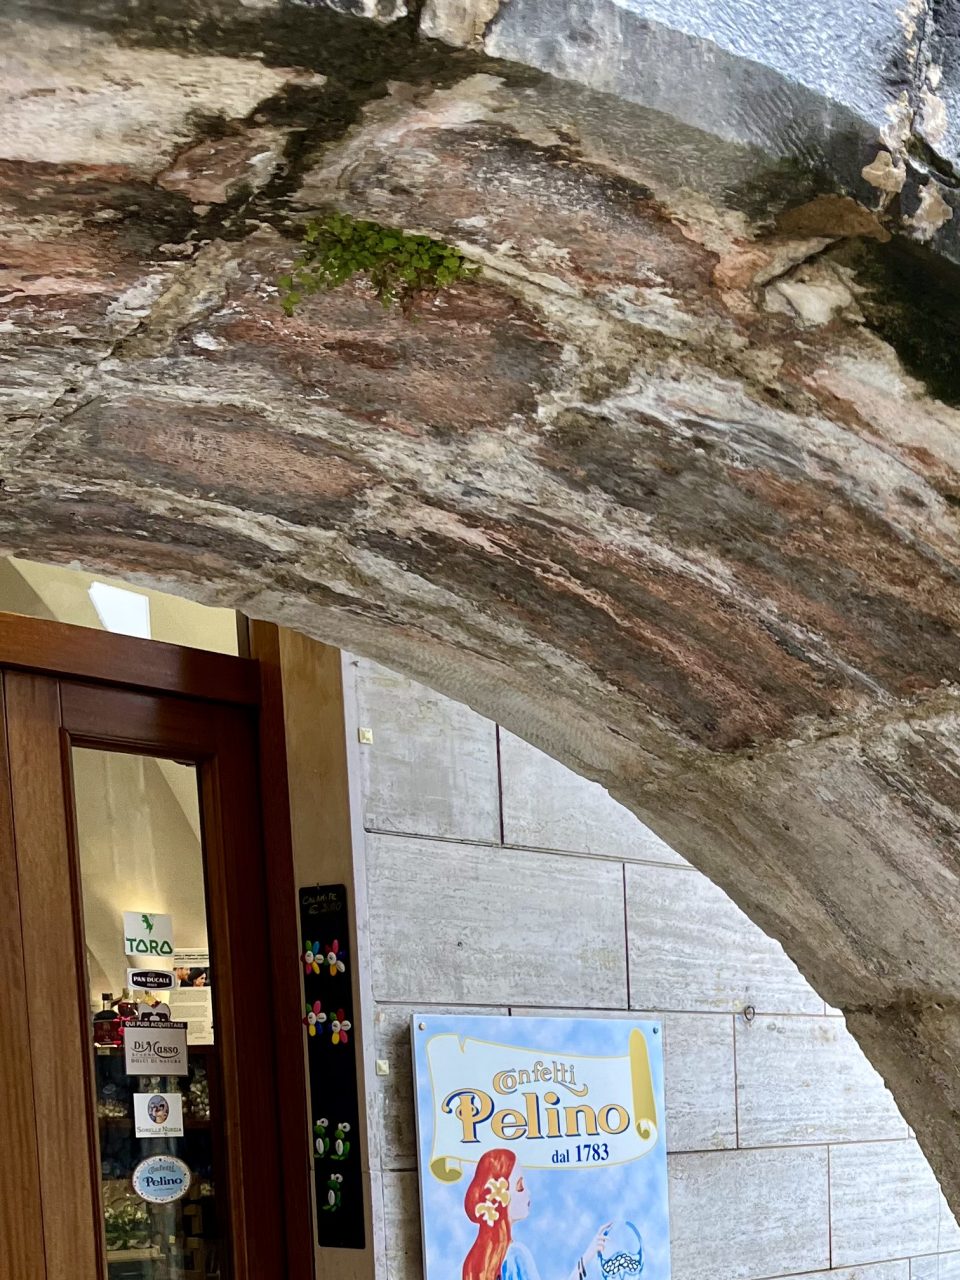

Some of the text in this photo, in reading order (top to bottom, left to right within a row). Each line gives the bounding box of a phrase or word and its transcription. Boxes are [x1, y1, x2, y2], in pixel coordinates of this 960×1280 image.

[126, 936, 173, 956] TORO
[492, 1060, 589, 1097] Confetti
[442, 1088, 631, 1144] Pelino
[552, 1143, 610, 1164] dal 1783
[143, 1176, 182, 1187] Pelino
